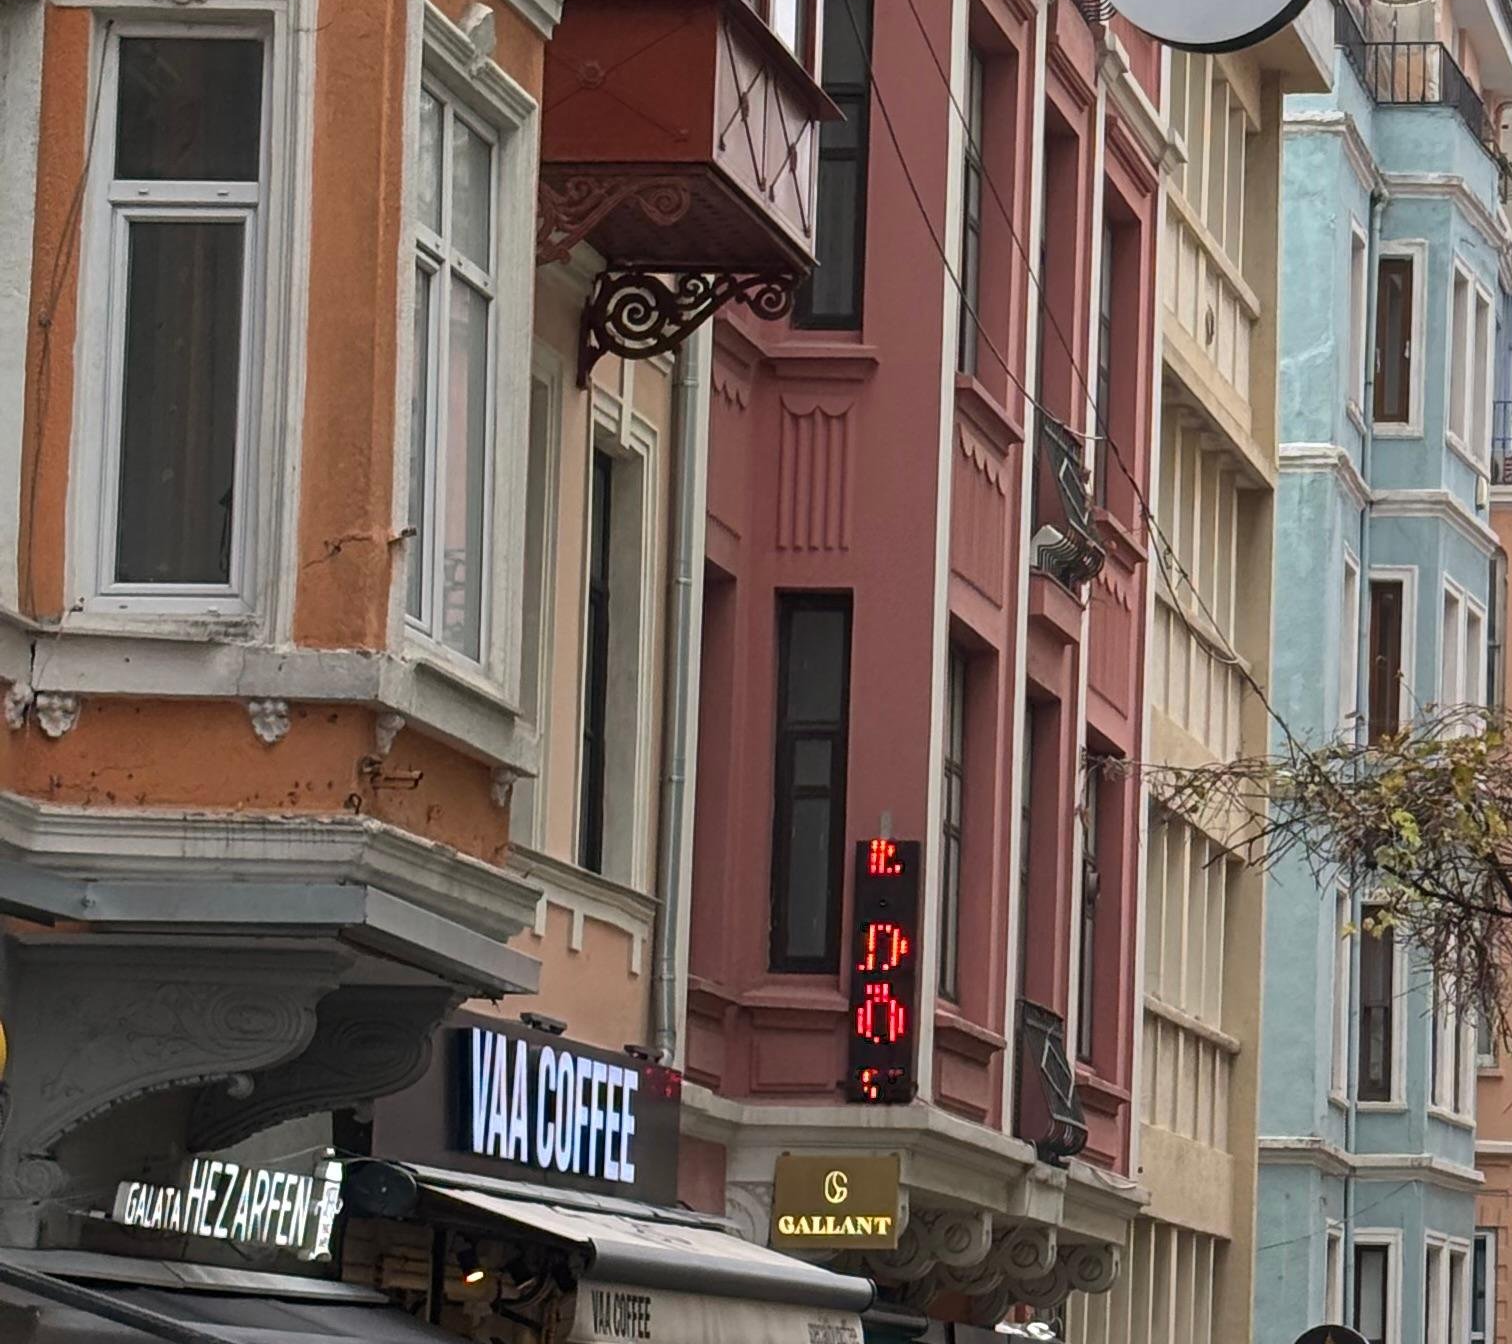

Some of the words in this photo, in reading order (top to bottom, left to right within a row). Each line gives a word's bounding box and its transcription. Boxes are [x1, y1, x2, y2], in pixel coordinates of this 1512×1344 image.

[472, 1027, 528, 1163] VAA
[536, 1045, 638, 1183] COFFEE
[124, 1181, 182, 1233] GALATA
[182, 1158, 314, 1248] HEZARFEN
[778, 1215, 892, 1235] GALLANT
[592, 1290, 612, 1335] VAA
[613, 1292, 651, 1339] COFFEE
